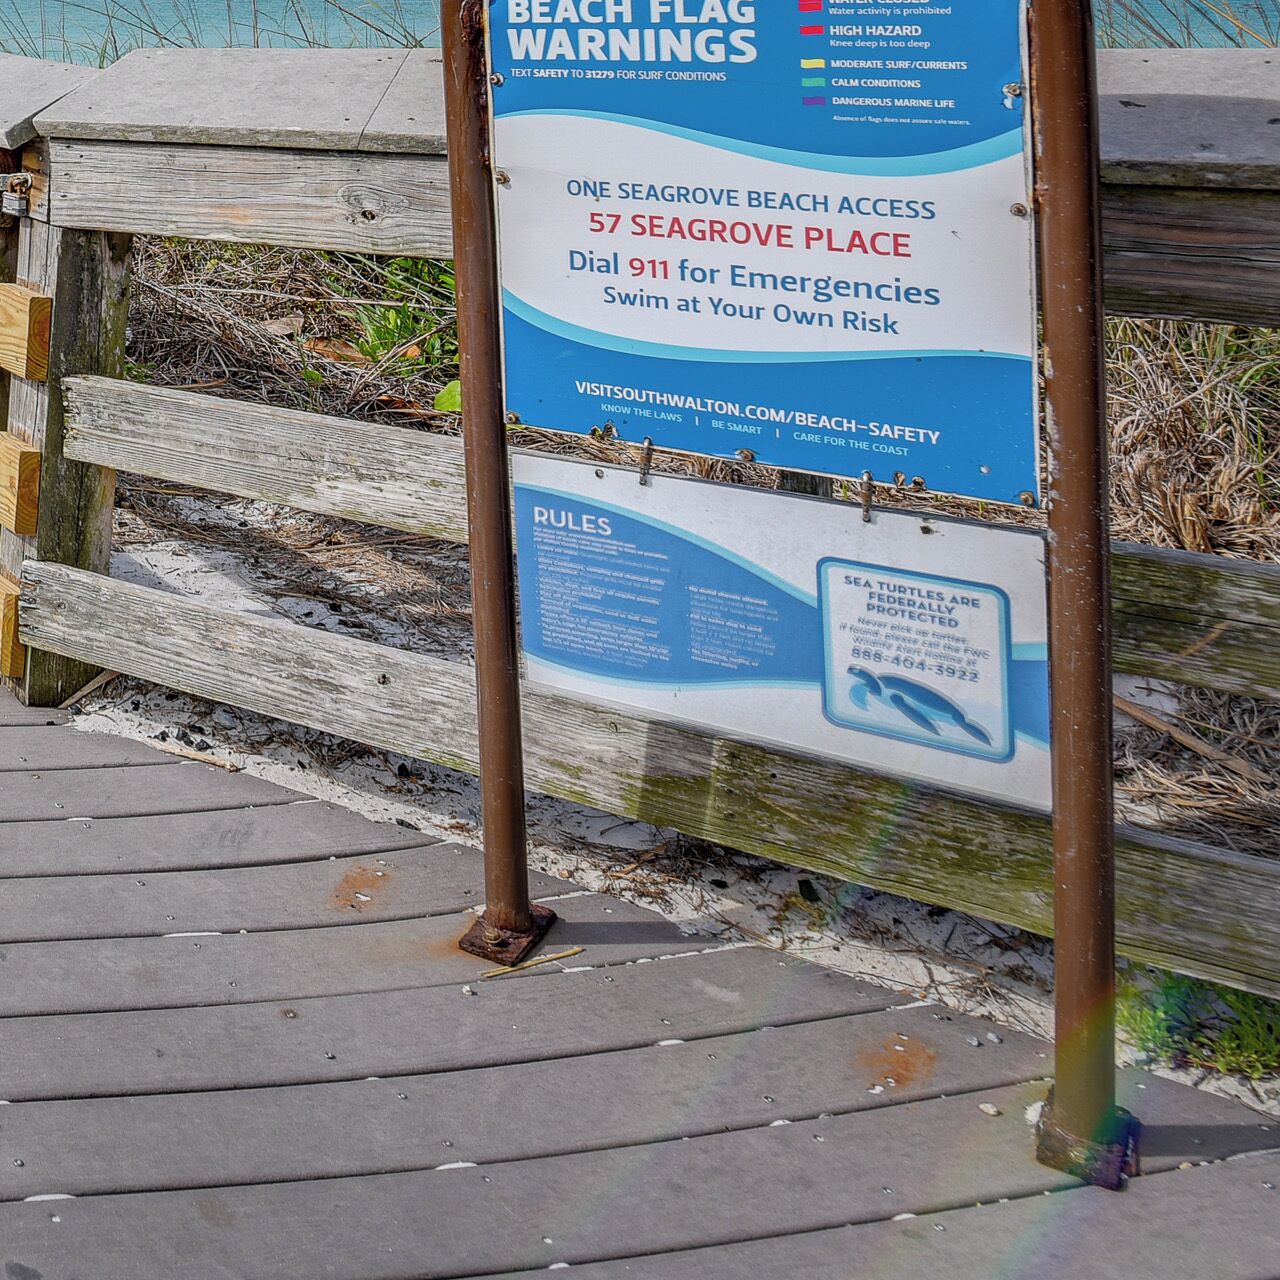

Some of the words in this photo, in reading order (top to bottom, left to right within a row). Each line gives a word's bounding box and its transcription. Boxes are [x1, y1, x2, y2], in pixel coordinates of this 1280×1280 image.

[828, 7, 855, 15] Water
[857, 7, 891, 17] activity
[893, 7, 901, 15] is
[903, 6, 952, 17] prohibited
[830, 25, 862, 36] HIGH
[866, 25, 922, 36] HAZARD
[506, 28, 758, 64] WARNINGS
[855, 40, 878, 49] deep
[880, 40, 887, 48] is
[889, 40, 905, 48] too
[907, 40, 931, 49] deep
[510, 68, 531, 77] TEXT
[533, 68, 568, 78] SAFETY
[571, 69, 583, 78] TO
[585, 70, 615, 79] 31279
[617, 70, 636, 79] FOR
[638, 70, 663, 80] SURF
[665, 70, 727, 81] CONDITIONS
[831, 59, 884, 69] MODERATE
[885, 60, 968, 70] SURF/CURRENTS
[832, 78, 859, 87] CALM
[861, 79, 921, 88] CONDITIONS
[832, 97, 892, 106] DANGEROUS
[894, 98, 933, 107] MARINE
[935, 99, 955, 108] LIFE
[567, 179, 611, 199] ONE
[618, 182, 740, 207] SEAGROVE
[747, 190, 829, 213] BEACH
[837, 196, 936, 220] ACCESS
[589, 212, 621, 234] 57
[630, 214, 793, 248] SEAGROVE
[804, 226, 912, 258] PLACE
[569, 249, 619, 275] Dial
[628, 257, 669, 280] 911
[678, 258, 720, 284] for
[730, 264, 941, 306] Emergencies
[603, 286, 669, 310] Swim
[677, 295, 701, 313] at
[708, 297, 765, 321] Your
[773, 303, 834, 328] Own
[842, 310, 899, 335] Risk
[575, 380, 941, 445] VISITSOUTHWALTON.COM/BEACH-SAFETY
[601, 403, 631, 415] KNOW
[633, 407, 653, 418] THE
[654, 410, 683, 423] LAWS
[711, 419, 725, 429] BE
[726, 421, 762, 435] SMART
[793, 431, 821, 443] CARE
[824, 435, 846, 447] FOR
[848, 439, 870, 451] THE
[872, 443, 909, 456] COAST
[533, 506, 612, 536] RULES
[844, 575, 872, 589] SEA
[877, 581, 945, 602] TURTLES
[949, 596, 981, 609] ARE
[868, 592, 956, 615] FEDERALLY
[857, 616, 888, 629] Never
[890, 623, 912, 634] pick
[915, 627, 929, 637] up
[866, 603, 959, 629] PROTECTED
[942, 642, 960, 653] the
[851, 647, 981, 684] 888-404-3922
